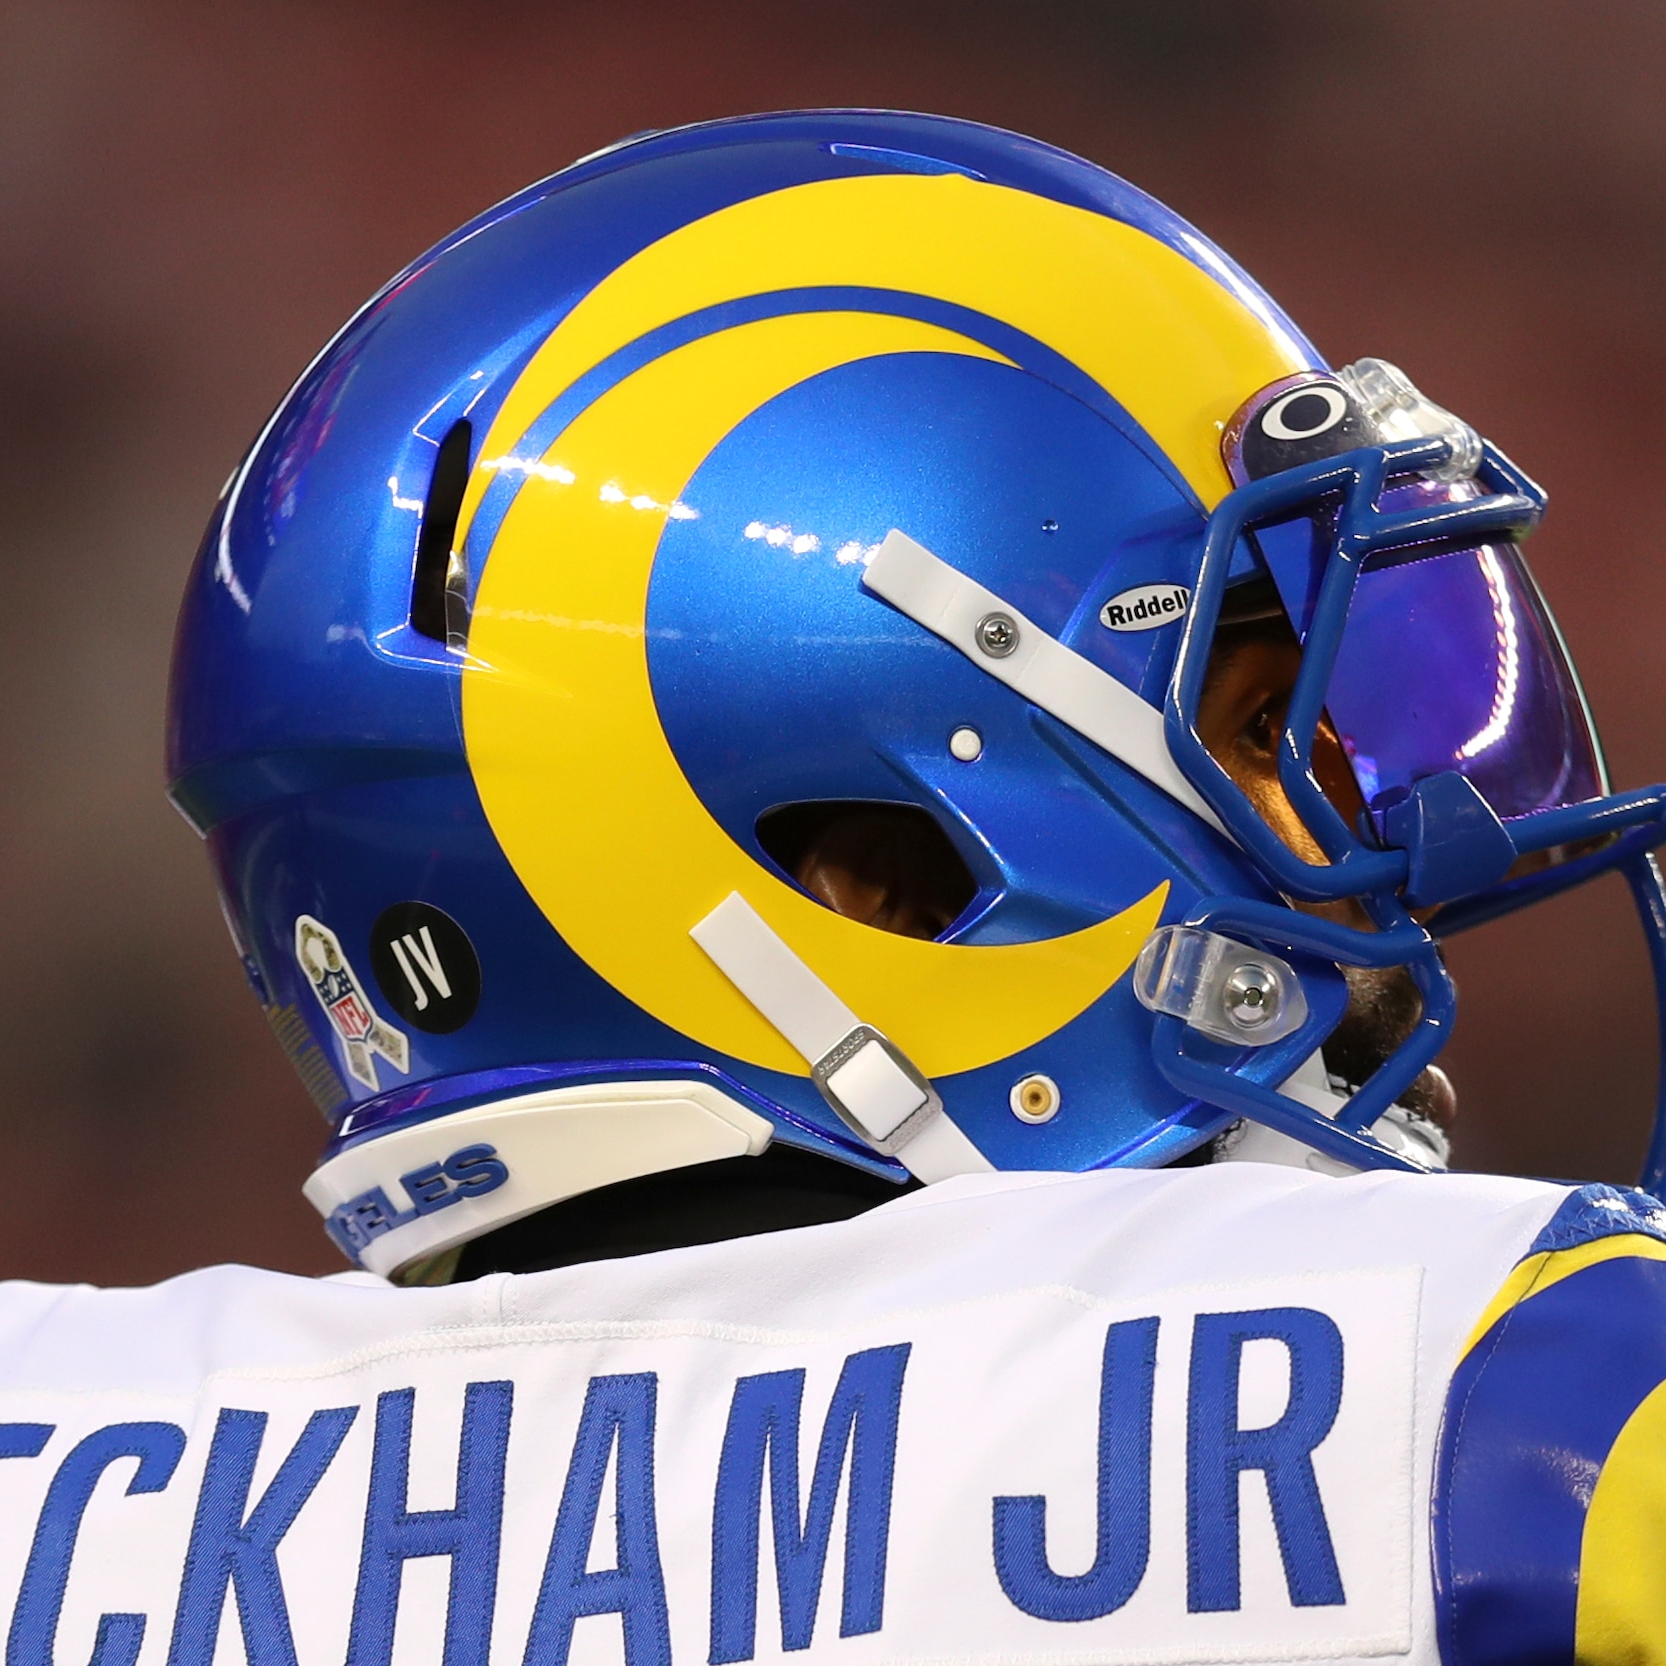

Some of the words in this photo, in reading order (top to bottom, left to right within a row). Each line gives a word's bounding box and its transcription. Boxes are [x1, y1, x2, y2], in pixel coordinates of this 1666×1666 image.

[1107, 589, 1188, 626] Riddell
[390, 925, 452, 1011] JV
[330, 995, 370, 1036] NFL
[992, 1306, 1346, 1622] JR
